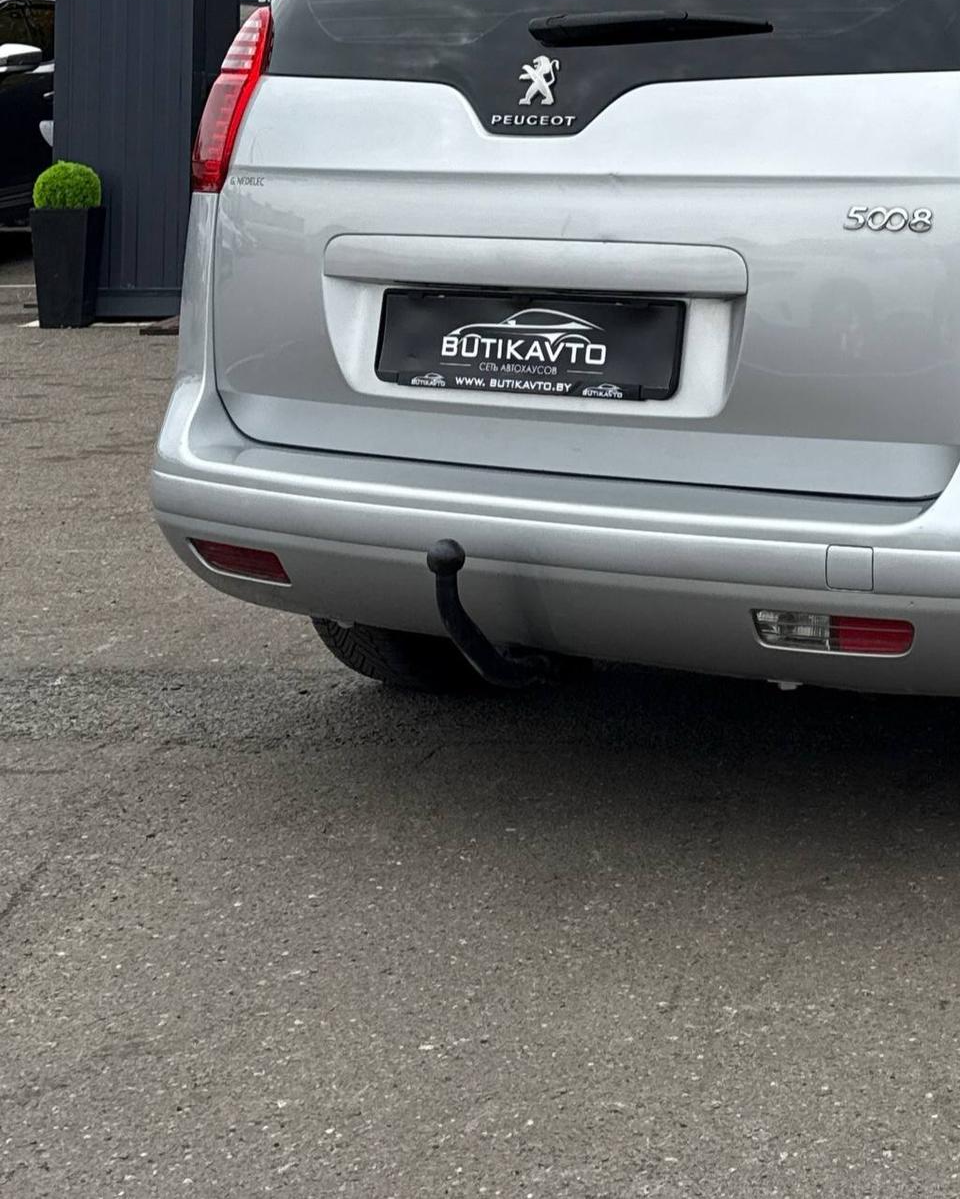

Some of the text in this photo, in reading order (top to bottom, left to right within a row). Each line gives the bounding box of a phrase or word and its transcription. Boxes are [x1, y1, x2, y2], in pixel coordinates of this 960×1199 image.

[490, 113, 577, 127] PEUGEOT
[843, 204, 933, 233] 5008
[441, 335, 607, 365] BUTIKAVTO
[479, 362, 558, 376] СЕТЬ АВТОХАУСОВ
[489, 378, 572, 393] BUTIKAVTO.BY
